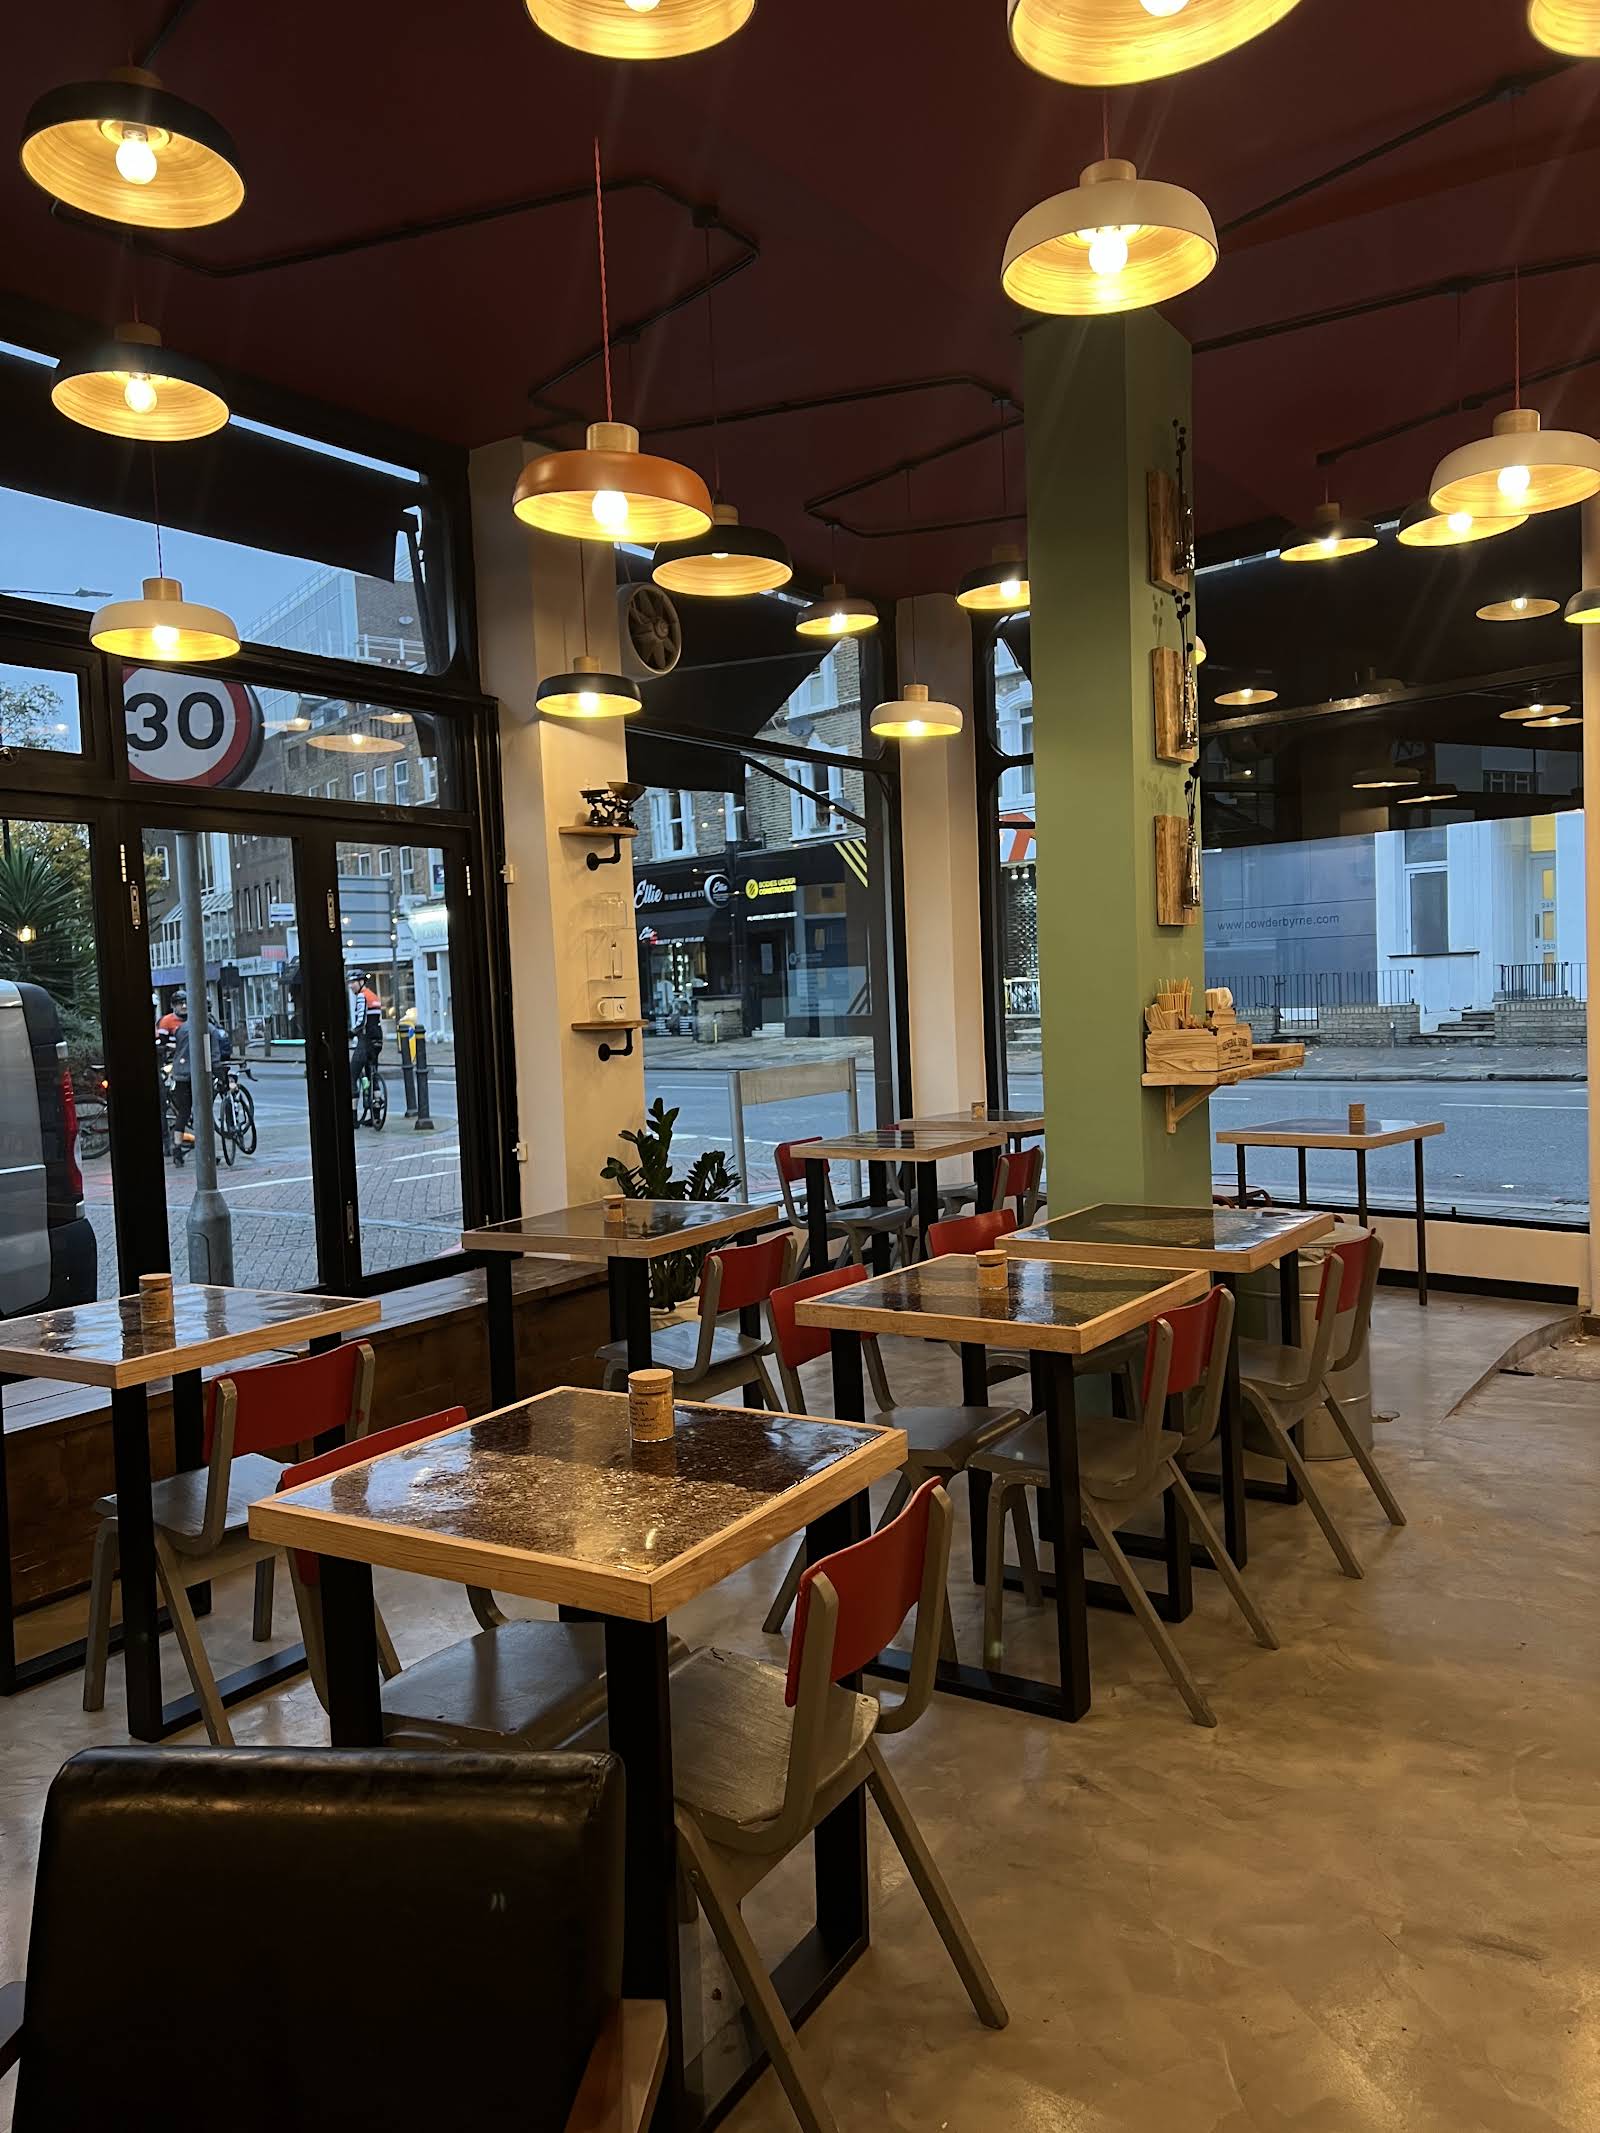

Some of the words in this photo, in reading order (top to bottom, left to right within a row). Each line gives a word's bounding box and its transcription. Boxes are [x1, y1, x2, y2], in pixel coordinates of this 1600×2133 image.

[125, 691, 225, 752] 30
[634, 879, 663, 909] Ellie
[1217, 915, 1340, 931] www.powderbyrne.com
